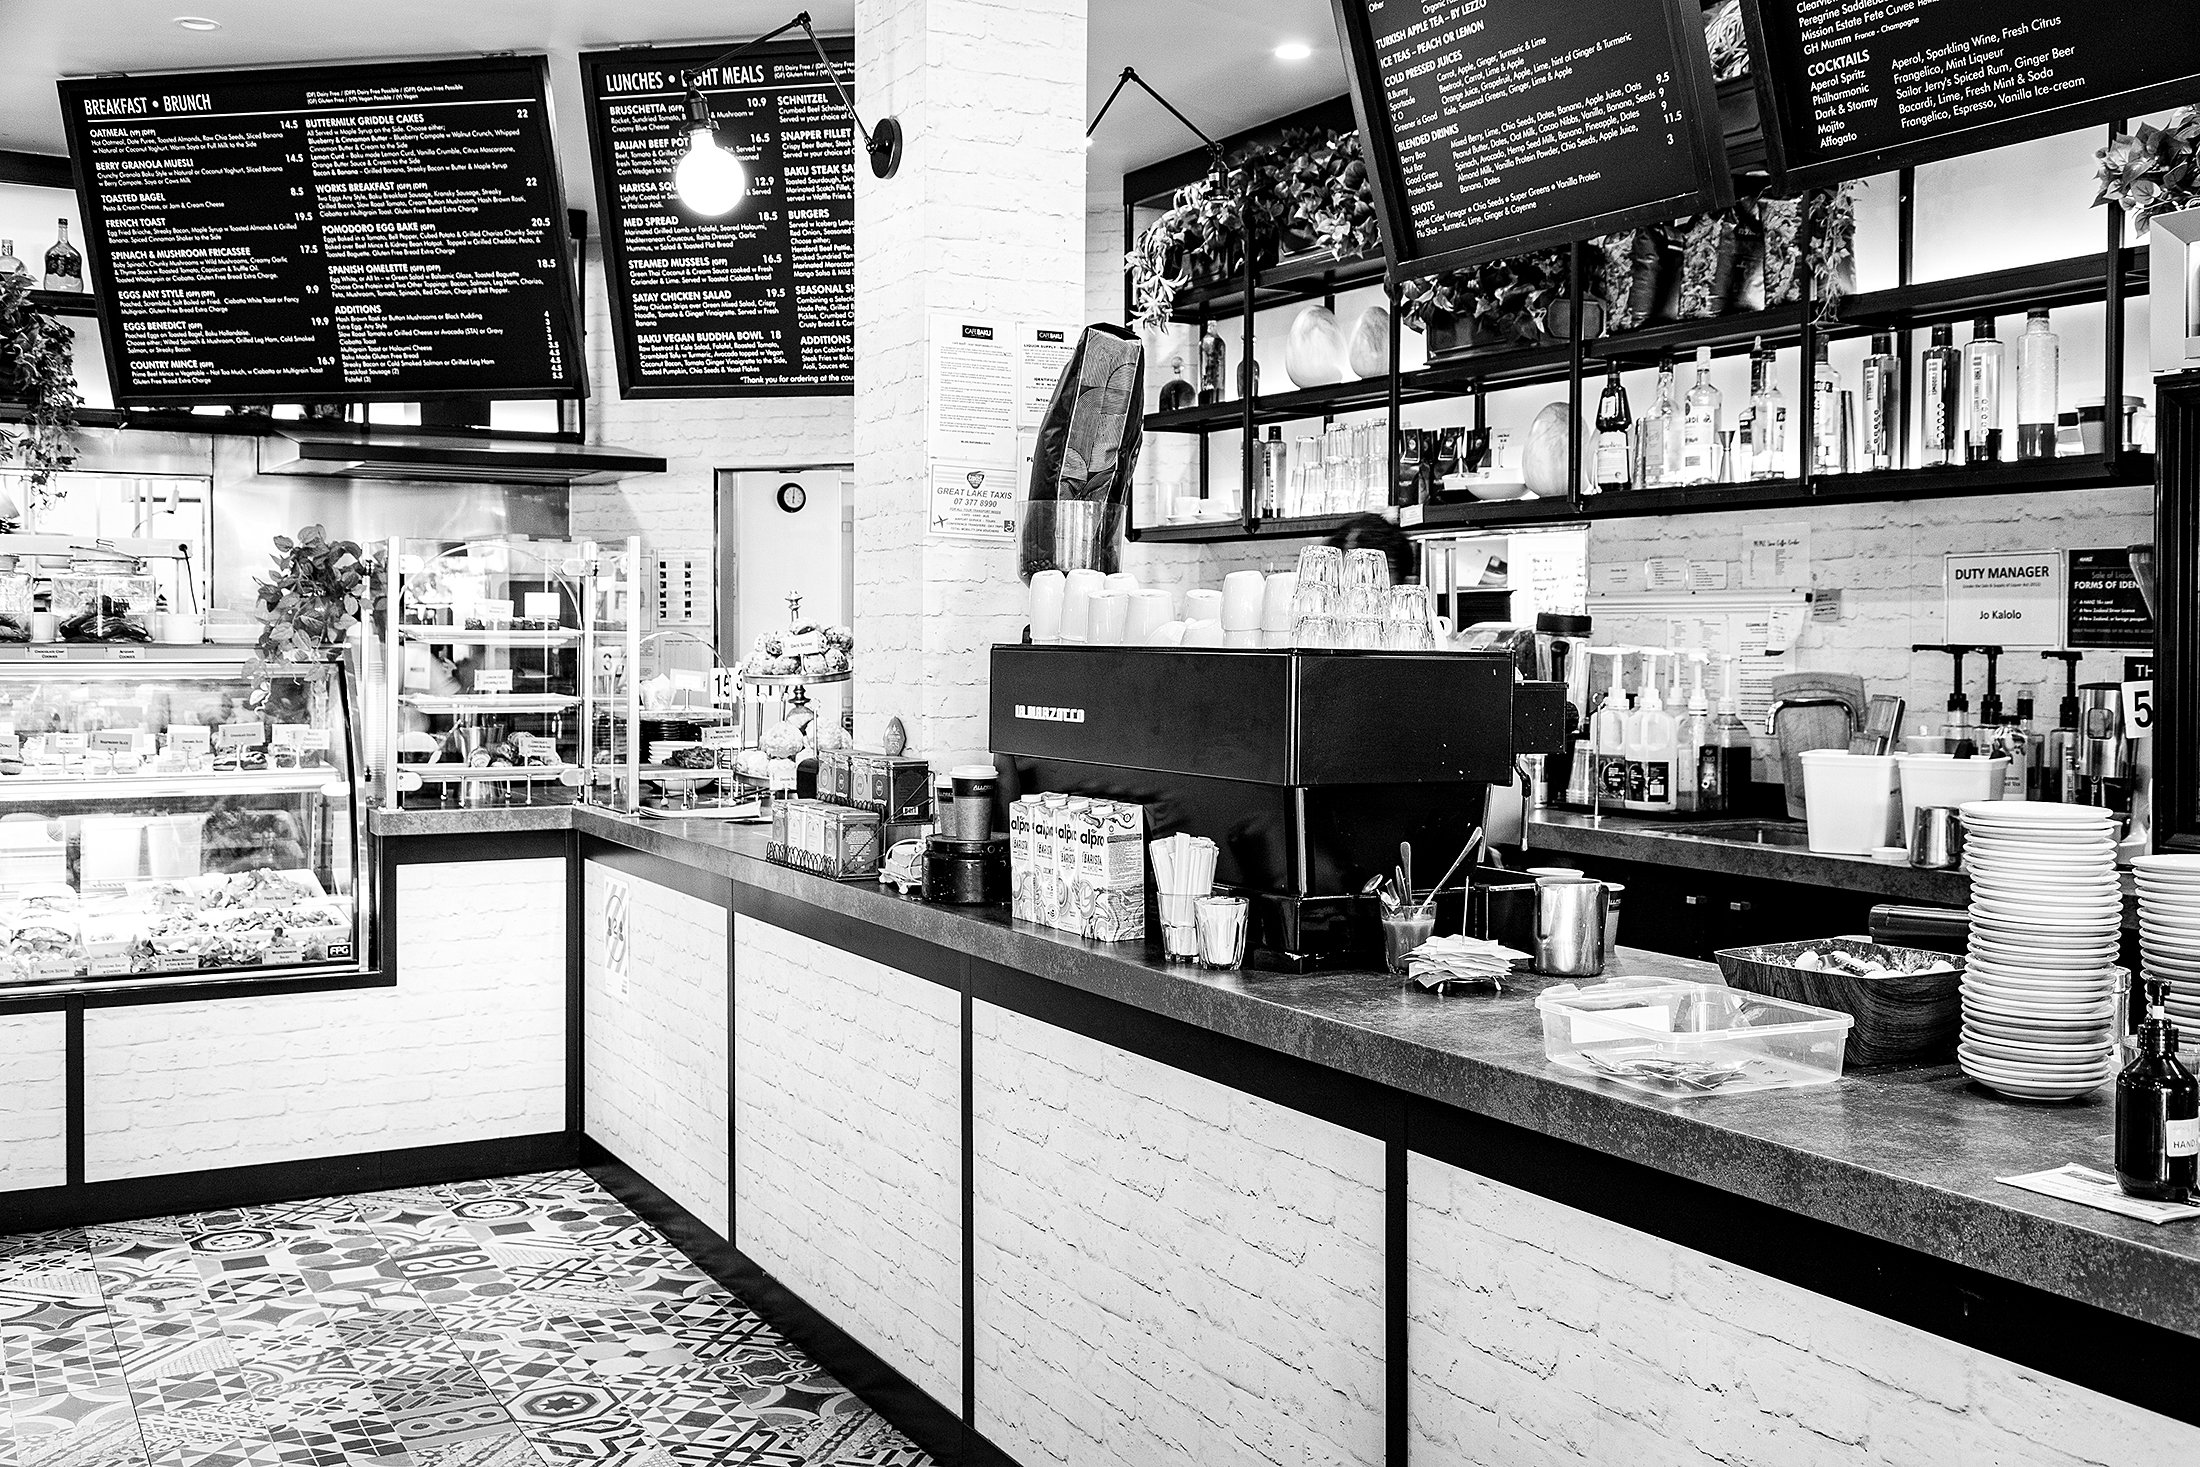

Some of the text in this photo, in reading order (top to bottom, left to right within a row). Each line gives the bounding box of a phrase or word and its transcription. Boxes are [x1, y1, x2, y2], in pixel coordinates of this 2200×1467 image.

[1799, 9, 1839, 27] Peregrine
[1802, 2, 1914, 41] Mission Estate Fete Cuvee
[1376, 29, 1406, 49] TURKISH
[1407, 20, 1428, 37] APPLE
[1428, 14, 1444, 28] TEA
[1450, 7, 1459, 20] BY
[1380, 55, 1392, 68] ICE
[1392, 48, 1411, 63] TEAS
[1417, 36, 1442, 54] PEACH
[1442, 31, 1455, 44] OR
[1455, 19, 1484, 39] LEMON
[1804, 42, 1819, 55] GH
[1821, 35, 1851, 50] Mumm
[1854, 30, 1875, 40] France
[1892, 16, 2061, 70] Aperol, Sparkling Wine, Fresh Citrus
[1384, 49, 1462, 87] COLD PRESSED JUICES
[1808, 49, 1869, 76] COCKTAILS
[1894, 48, 2004, 84] Frangelico, Mint Liqueur
[606, 65, 764, 91] LUNCHES LGHT MEALS
[1656, 71, 1669, 84] 9.5
[1896, 46, 2074, 99] Sailor Jerry's Spiced Rum, Ginger Beer
[1810, 69, 1865, 92] Aperol Spritz
[1812, 83, 1869, 105] Philharmonic
[1898, 66, 2053, 114] Bacardi, Lime, Fresh Mint & Soda
[84, 94, 211, 115] BREAKFAST BRUNCH
[747, 97, 766, 107] 10.9
[777, 93, 828, 105] SCHNITZEL
[1901, 77, 2085, 128] Frangelico, Espresso, Vanilla Ice-cream
[517, 109, 528, 118] 22
[610, 103, 666, 115] BRUSCHETTA
[1815, 98, 1878, 120] Dark & Stormy
[305, 113, 424, 128] BUTTERMILK GRIDDLE CAKES
[1664, 110, 1682, 123] 11.5
[1818, 120, 1845, 134] Mojito
[780, 128, 851, 141] SNAPPER FILLET
[1398, 123, 1459, 151] BLENDED DRINKS
[1820, 132, 1857, 148] Affogato
[285, 154, 303, 162] 14.5
[95, 162, 119, 170] BERRY
[121, 160, 163, 169] GRANOLA
[315, 182, 394, 193] WORKS BREAKFAST
[526, 177, 537, 186] 22
[100, 192, 166, 203] TOASTED BAGEL
[290, 187, 304, 196] 8.5
[788, 208, 829, 219] BURGERS
[1411, 200, 1435, 215] SHOTS
[294, 212, 312, 220] 19.5
[531, 217, 550, 226] 20.5
[623, 216, 678, 227] MED SPREAD
[758, 211, 777, 221] 18.5
[105, 218, 165, 227] FRENCH TOAST
[322, 222, 418, 234] POMODORO EGG BAKE
[537, 259, 556, 268] 18.5
[628, 257, 710, 269] STEAMED MUSSELS
[762, 254, 782, 263] 16.5
[328, 263, 408, 274] SPANISH OMELETTE
[632, 290, 731, 302] SATAY CHICKEN SALAD
[766, 288, 785, 297] 19.5
[334, 304, 382, 314] ADDITIONS
[123, 321, 186, 330] EGGS BENEDICT
[311, 317, 329, 325] 19.9
[637, 331, 764, 343] BAKU VEGAN BUDDHA BOWL
[770, 330, 781, 339] 18
[937, 487, 965, 495] GREAT
[990, 491, 1012, 500] TAXIS
[1956, 566, 2049, 580] DUTY MANAGER
[1980, 610, 2021, 619] Jo Kalolo
[1080, 829, 1104, 849] alpro
[330, 946, 348, 955] FPG
